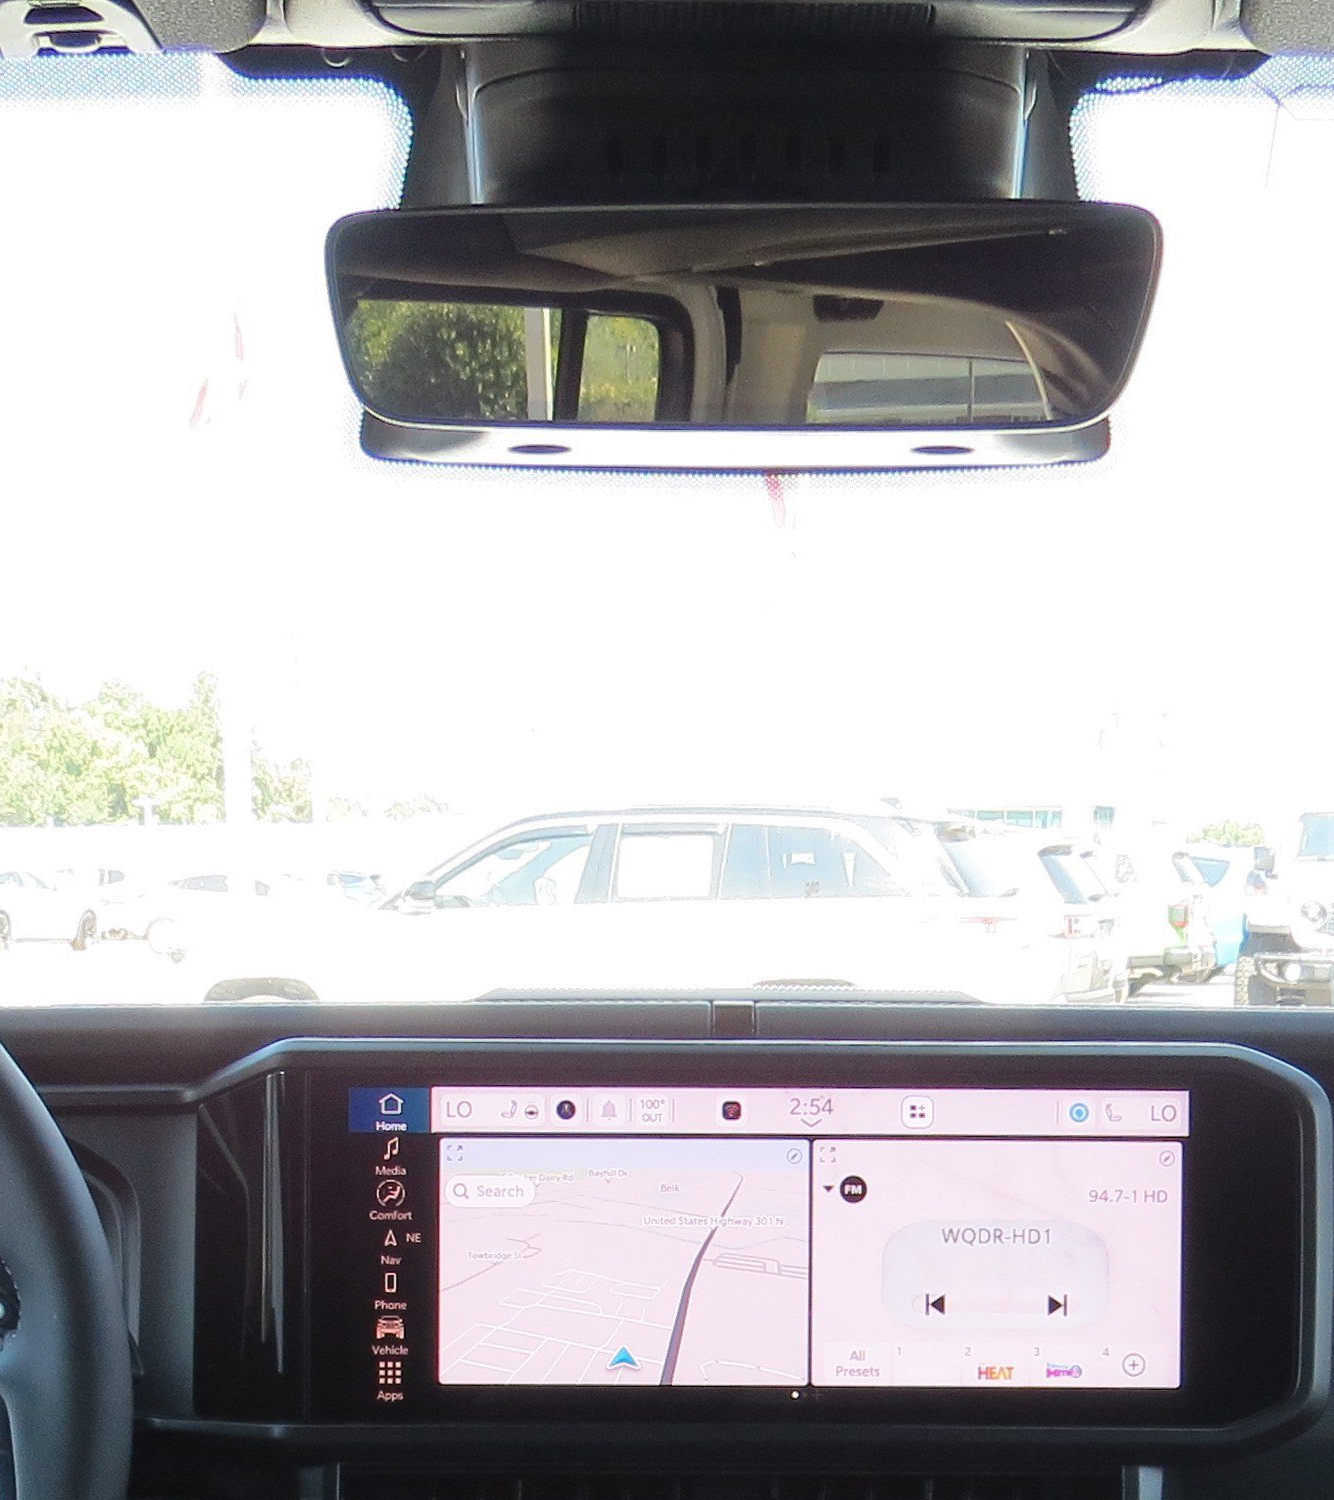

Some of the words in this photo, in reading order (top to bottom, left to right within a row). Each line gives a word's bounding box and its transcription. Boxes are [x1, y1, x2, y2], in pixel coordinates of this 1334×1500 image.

[445, 1100, 473, 1119] LO
[640, 1099, 666, 1110] 100°
[788, 1097, 834, 1116] 2:54
[1149, 1103, 1178, 1122] LO
[641, 1113, 663, 1123] OUT
[375, 1121, 408, 1132] Home
[375, 1165, 407, 1176] Media
[476, 1184, 525, 1198] Search
[843, 1184, 863, 1196] FM
[1087, 1189, 1139, 1203] 94.7-1
[1143, 1189, 1168, 1203] HD
[369, 1209, 413, 1221] Comfort
[643, 1216, 677, 1226] United
[678, 1216, 708, 1226] States
[710, 1216, 753, 1228] Highway
[756, 1216, 773, 1226] 301
[405, 1232, 422, 1243] NE
[941, 1227, 1052, 1245] WQDR-HD1
[380, 1255, 402, 1265] Nav
[374, 1300, 407, 1311] Phone
[371, 1345, 409, 1355] Vehicle
[849, 1349, 867, 1362] All
[964, 1346, 972, 1357] 2
[1033, 1346, 1041, 1358] 3
[1101, 1347, 1110, 1358] 4
[835, 1365, 881, 1379] Presets
[977, 1366, 1014, 1380] HEAT
[376, 1390, 404, 1402] Apps
